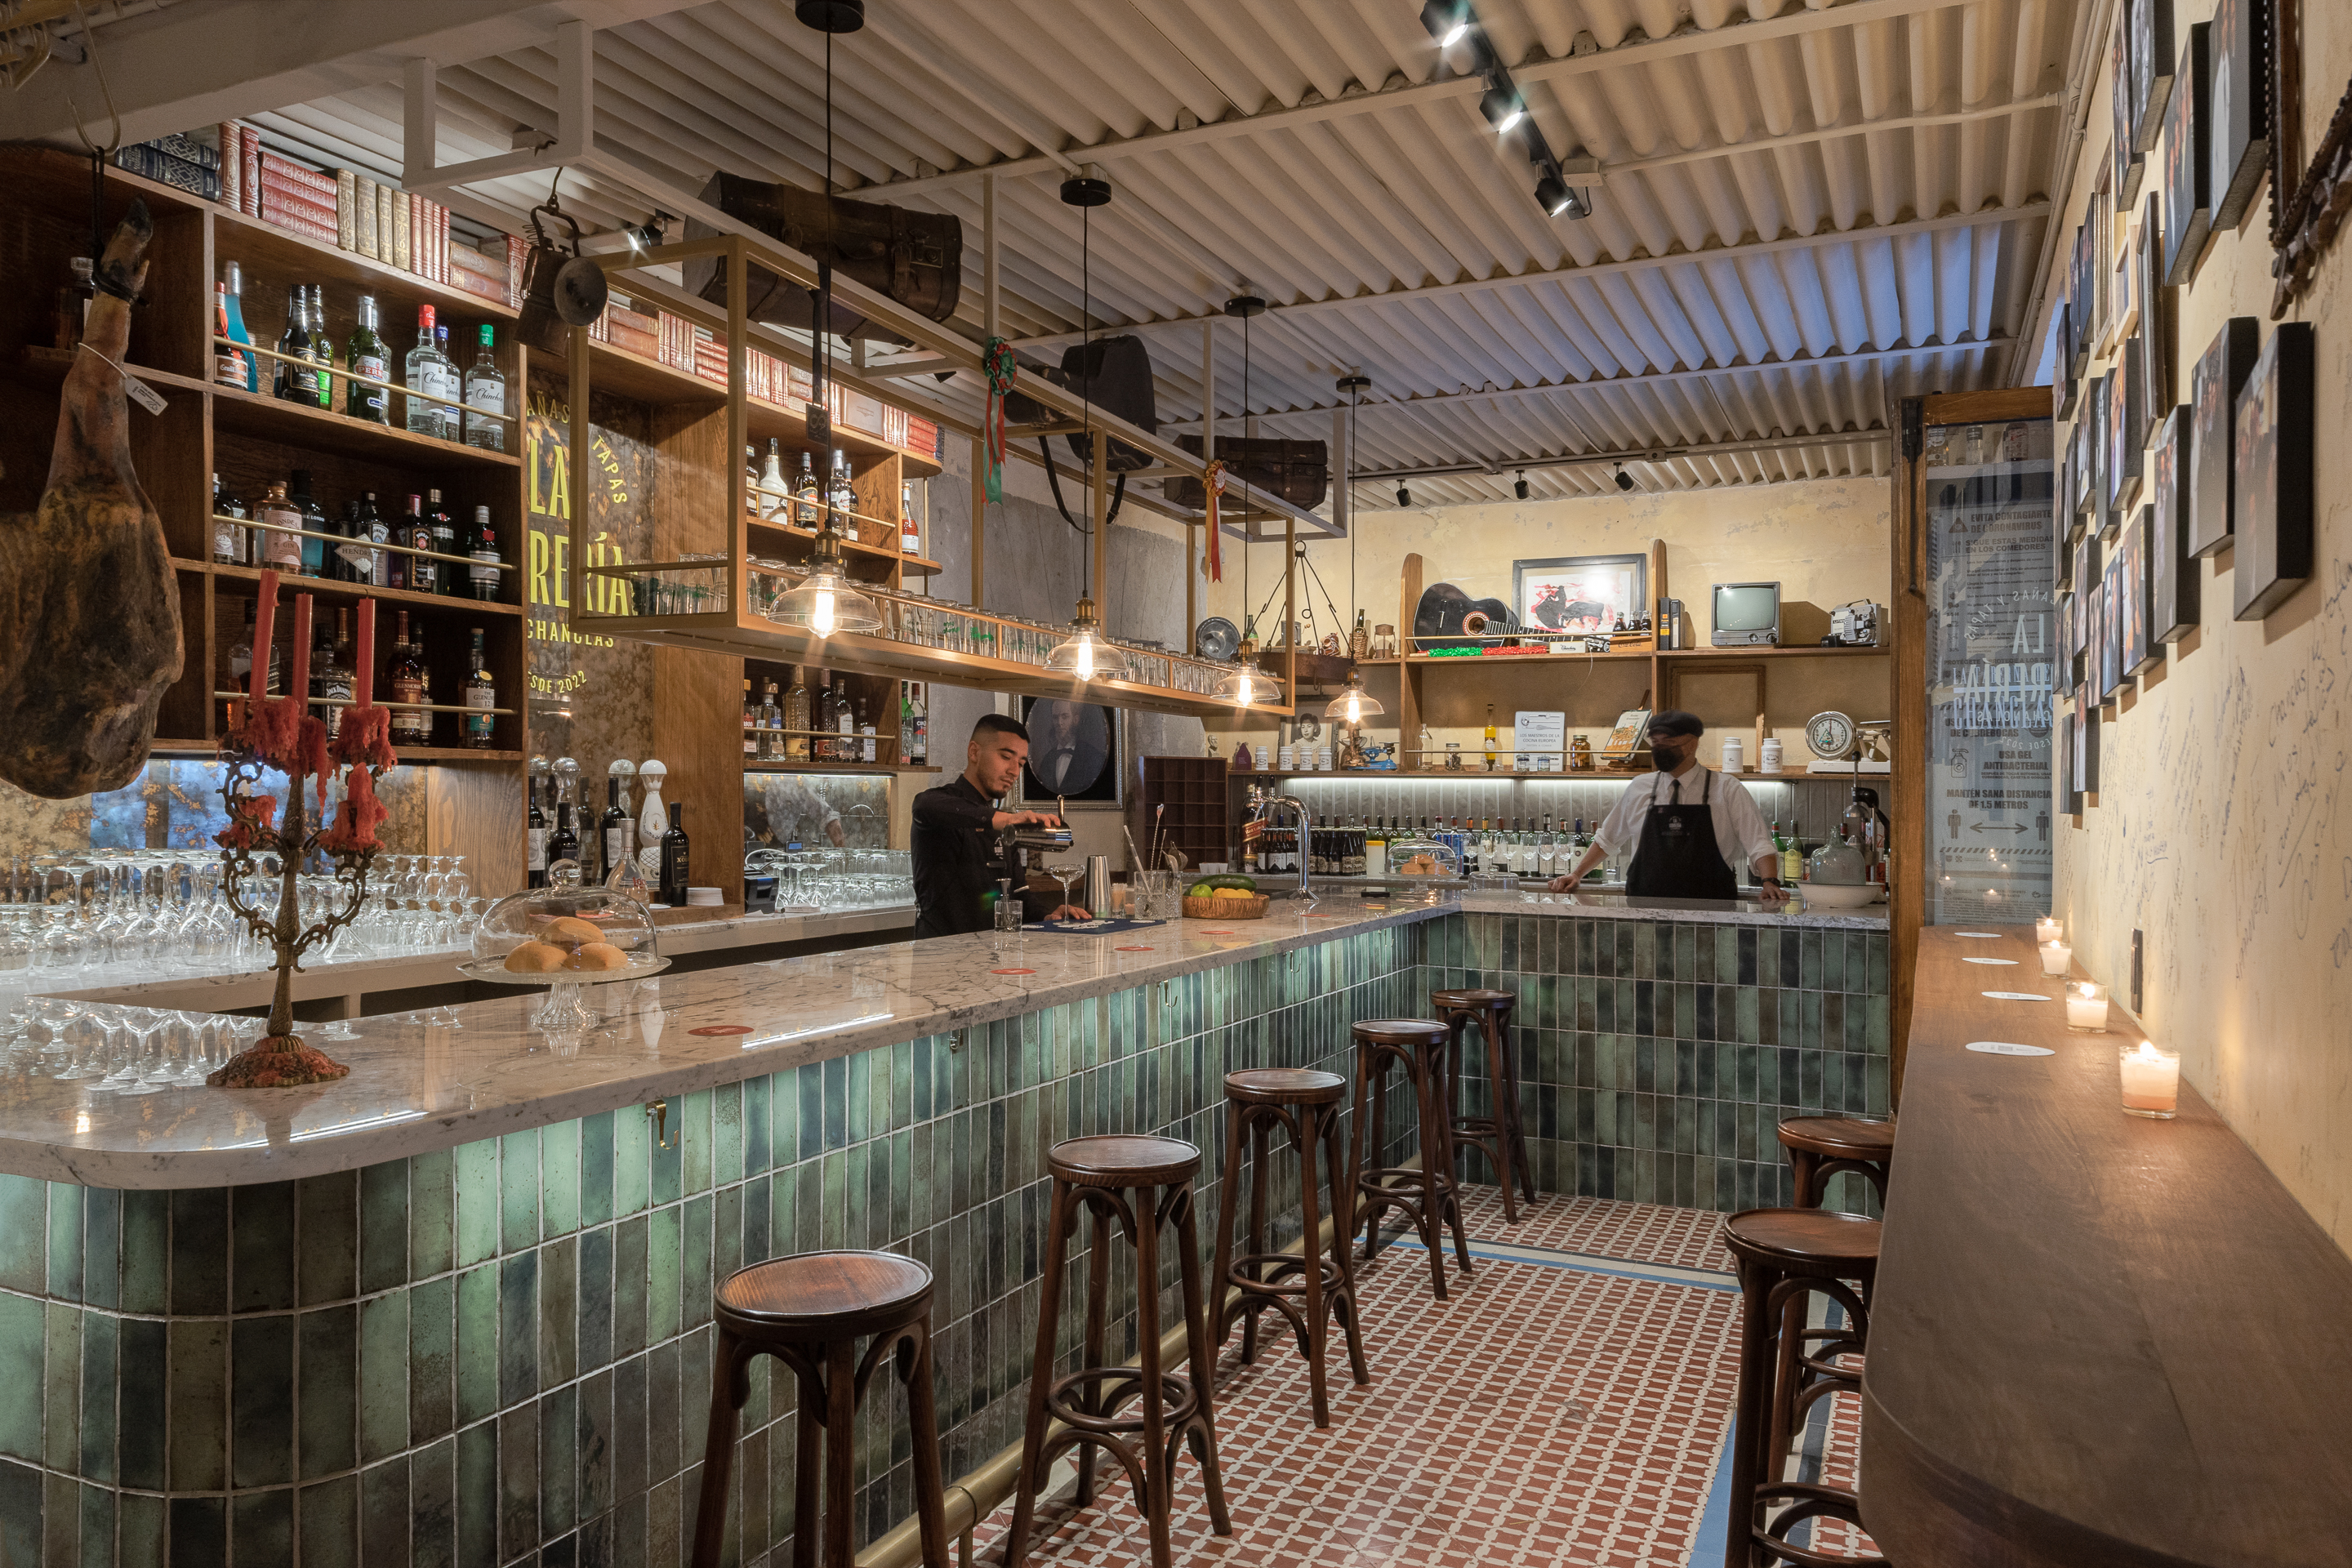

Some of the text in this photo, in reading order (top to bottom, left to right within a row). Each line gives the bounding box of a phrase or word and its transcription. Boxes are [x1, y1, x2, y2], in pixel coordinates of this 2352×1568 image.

[358, 365, 383, 376] PERN
[526, 390, 570, 424] AÑAS
[591, 434, 628, 504] TAPAS
[530, 439, 570, 520] LA
[1971, 509, 2052, 523] EVITA CONTAGIARTE
[1971, 521, 2042, 533] DE CORONAVIRUS
[2019, 535, 2054, 544] MEDIDAS
[1995, 543, 2046, 552] COMEDORES
[529, 530, 630, 617] REÍA
[528, 670, 587, 693] SDE 2022
[1950, 728, 1961, 737] DE
[1998, 751, 2033, 760] USA GEL
[1983, 761, 2049, 770] ANTIBACTERIAL
[1946, 788, 2052, 799] MANTÉN SANA DISTANCIA
[1968, 800, 2029, 809] DE 1.5 METROS
